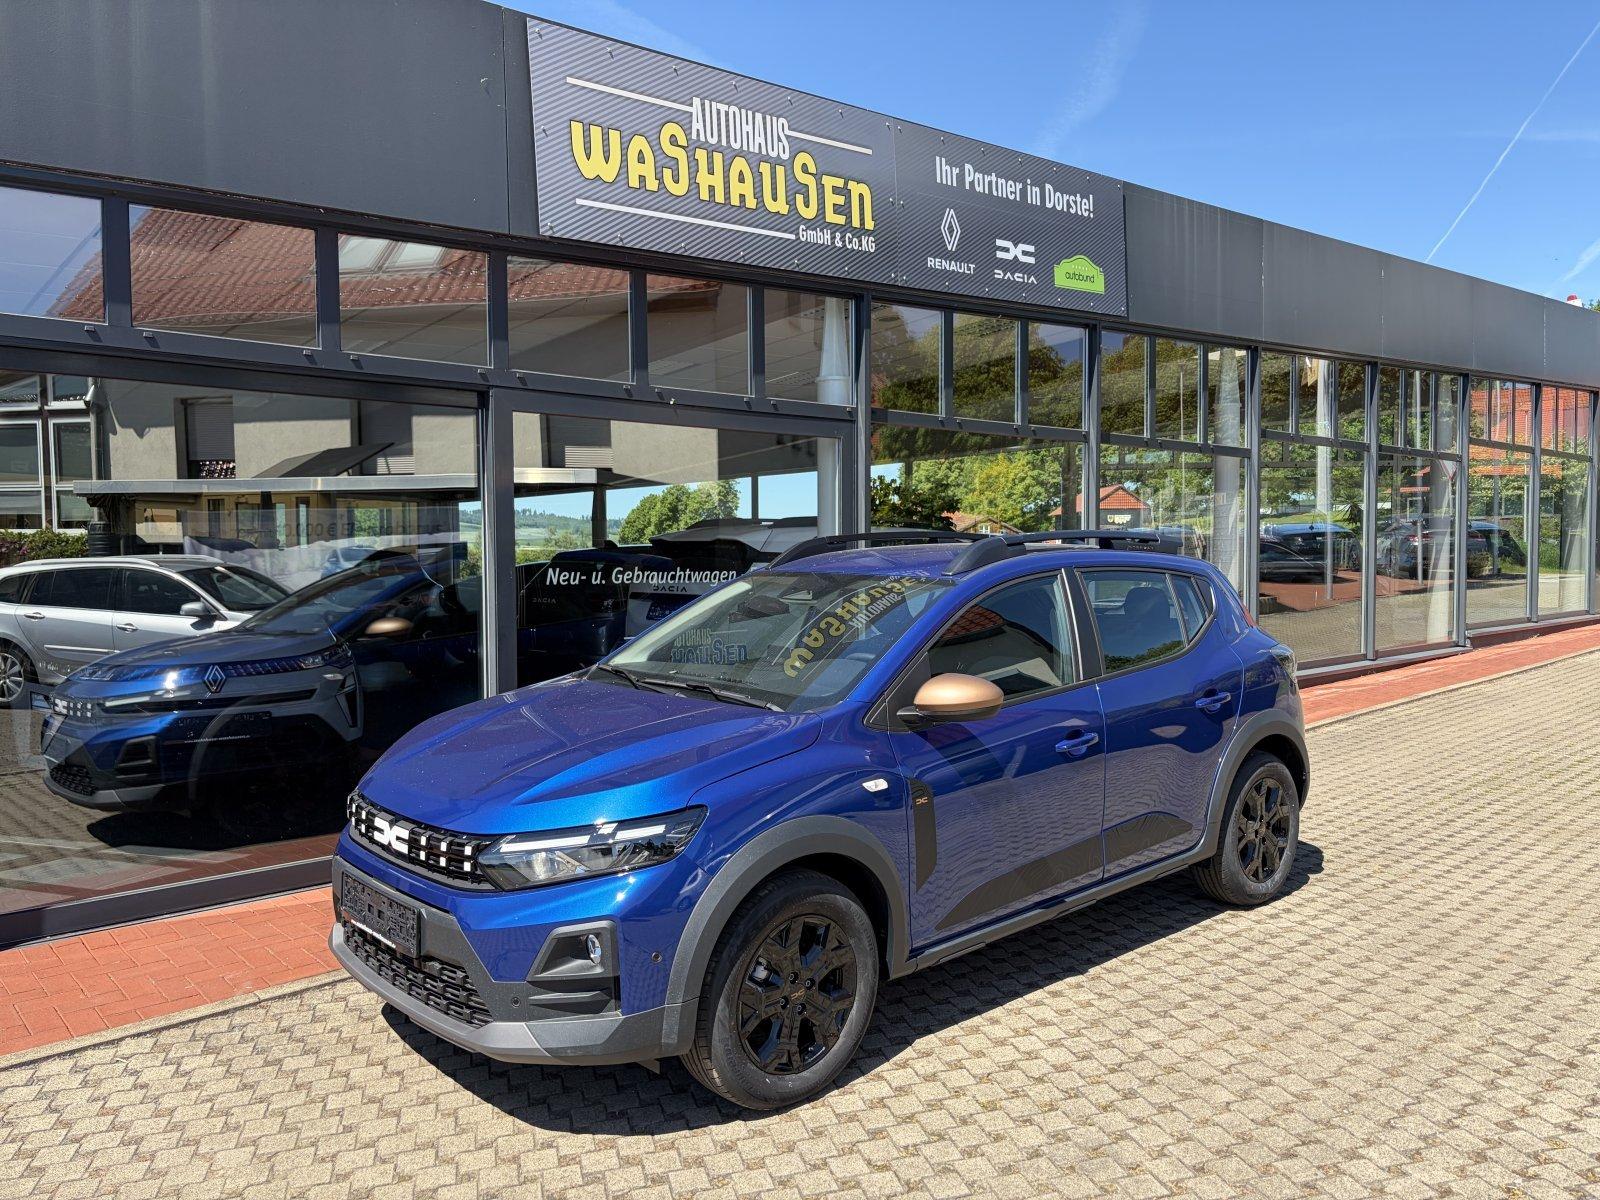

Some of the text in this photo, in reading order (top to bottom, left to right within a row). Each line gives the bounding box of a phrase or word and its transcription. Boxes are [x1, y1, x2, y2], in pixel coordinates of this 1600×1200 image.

[692, 97, 790, 160] AUTOHAUS
[935, 156, 1094, 218] Ihr Partner in Dorste!
[799, 224, 832, 247] GmbH
[834, 233, 843, 248] &
[927, 257, 976, 275] RENAULT
[994, 269, 1038, 284] DACIA
[546, 567, 737, 587] Neu- u. Gebrauchtwagen
